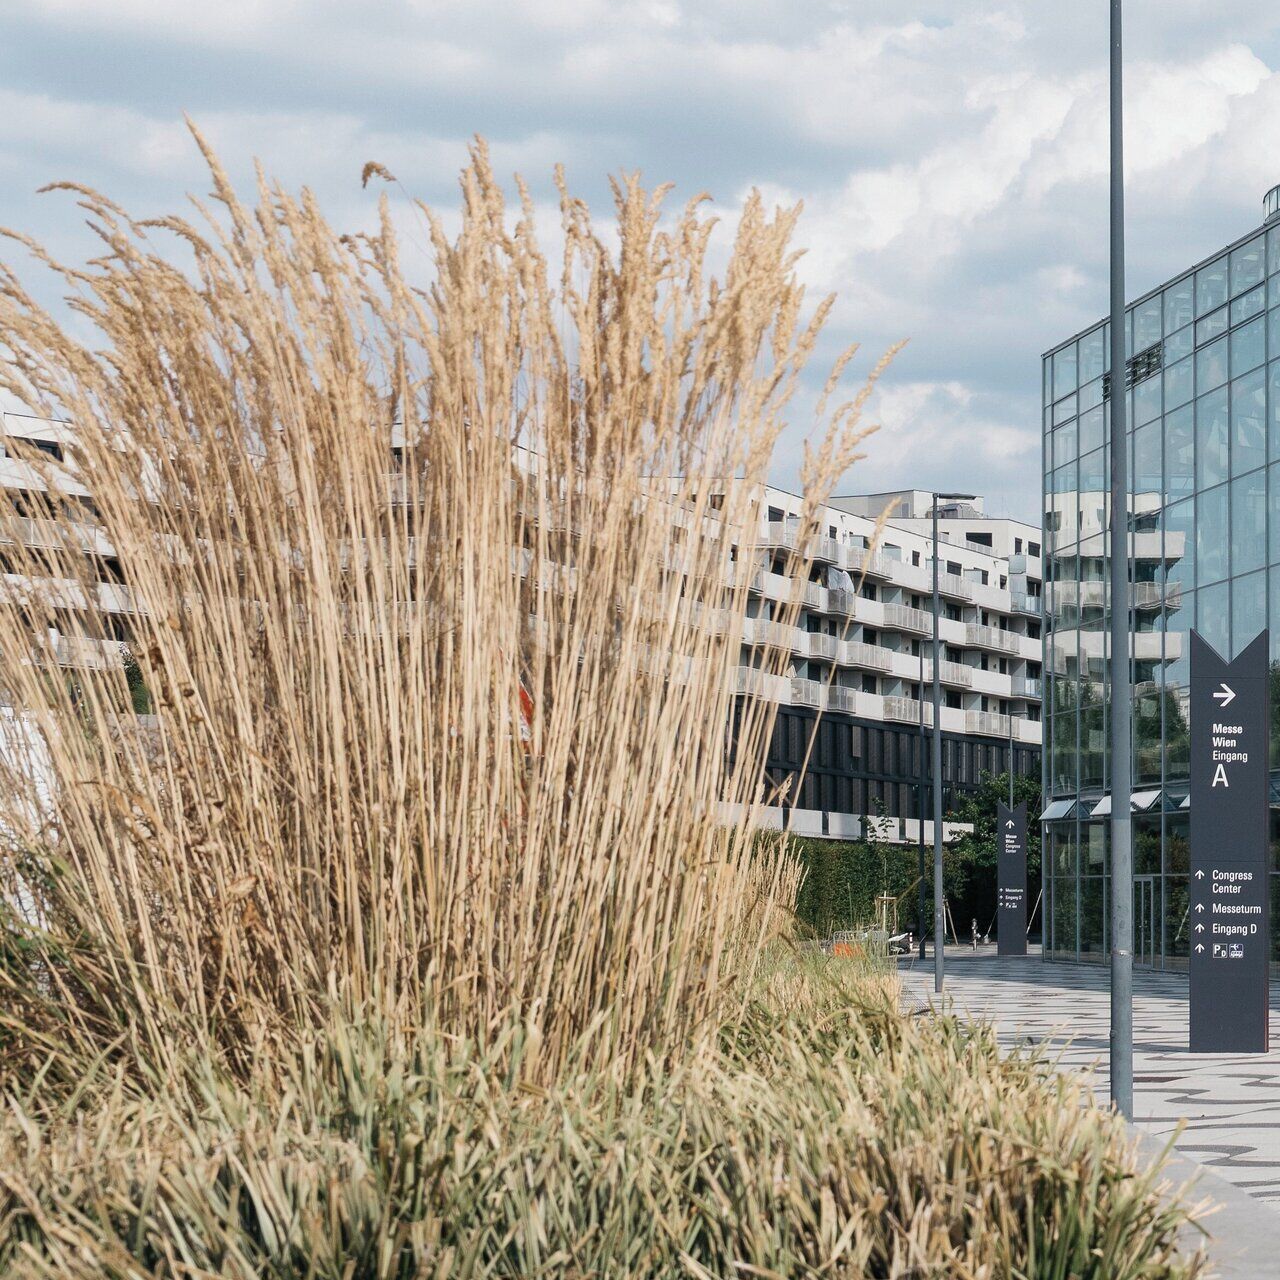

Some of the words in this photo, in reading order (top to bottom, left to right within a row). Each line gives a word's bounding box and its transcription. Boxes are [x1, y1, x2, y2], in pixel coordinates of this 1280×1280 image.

[1212, 723, 1243, 734] Messe
[1212, 736, 1237, 748] Wien
[1212, 750, 1248, 763] Eingang
[1211, 763, 1229, 788] A
[1212, 869, 1253, 883] Congress
[1212, 882, 1242, 894] Center
[1212, 903, 1262, 914] Messeturm
[1212, 923, 1248, 936] Eingang
[1250, 923, 1257, 934] D
